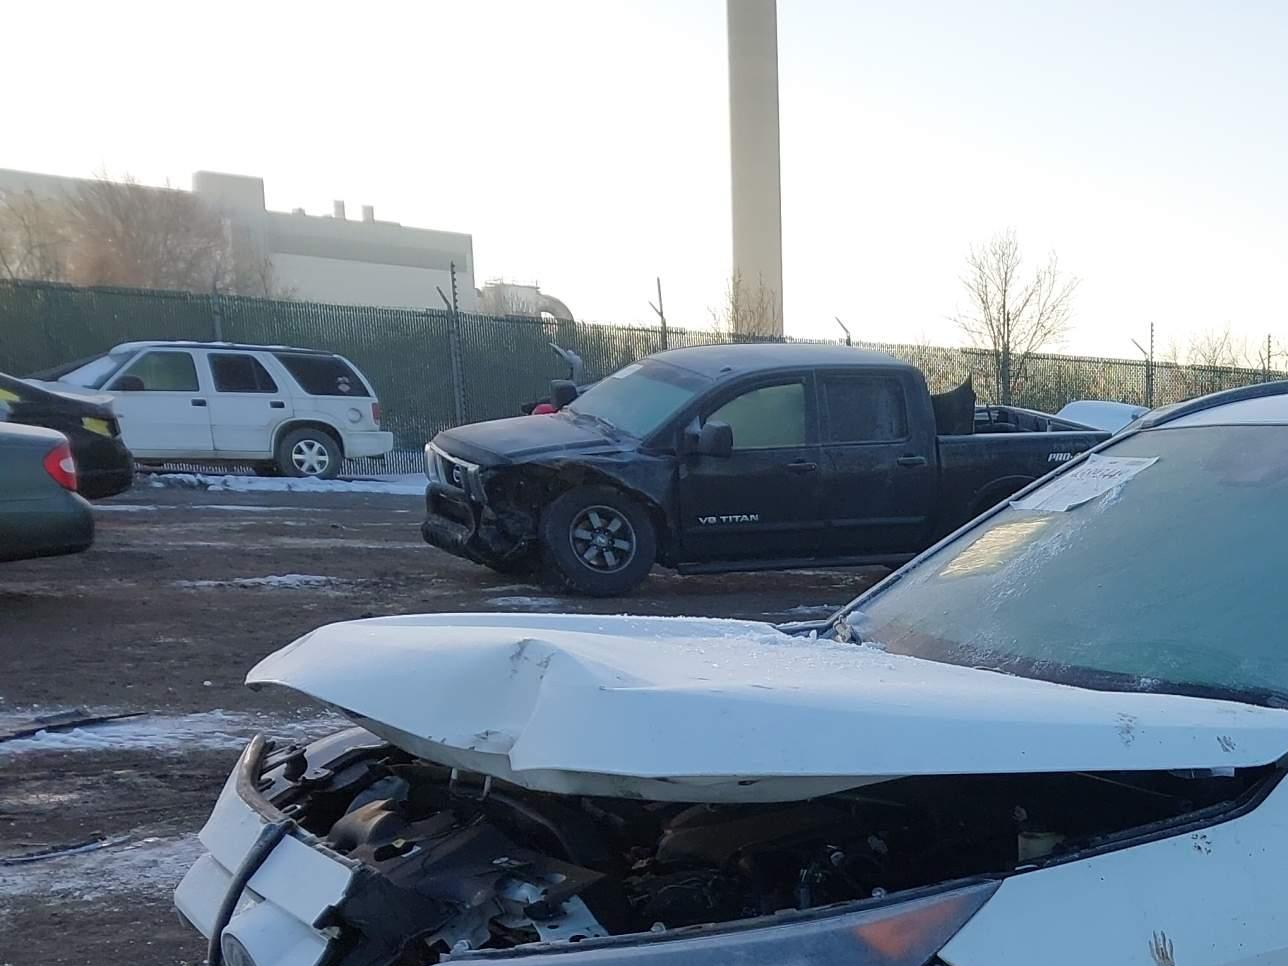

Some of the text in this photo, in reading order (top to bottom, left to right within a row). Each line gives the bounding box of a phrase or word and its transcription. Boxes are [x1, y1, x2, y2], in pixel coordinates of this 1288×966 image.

[1047, 452, 1080, 462] PRO-
[698, 514, 759, 524] V8 TITAN
